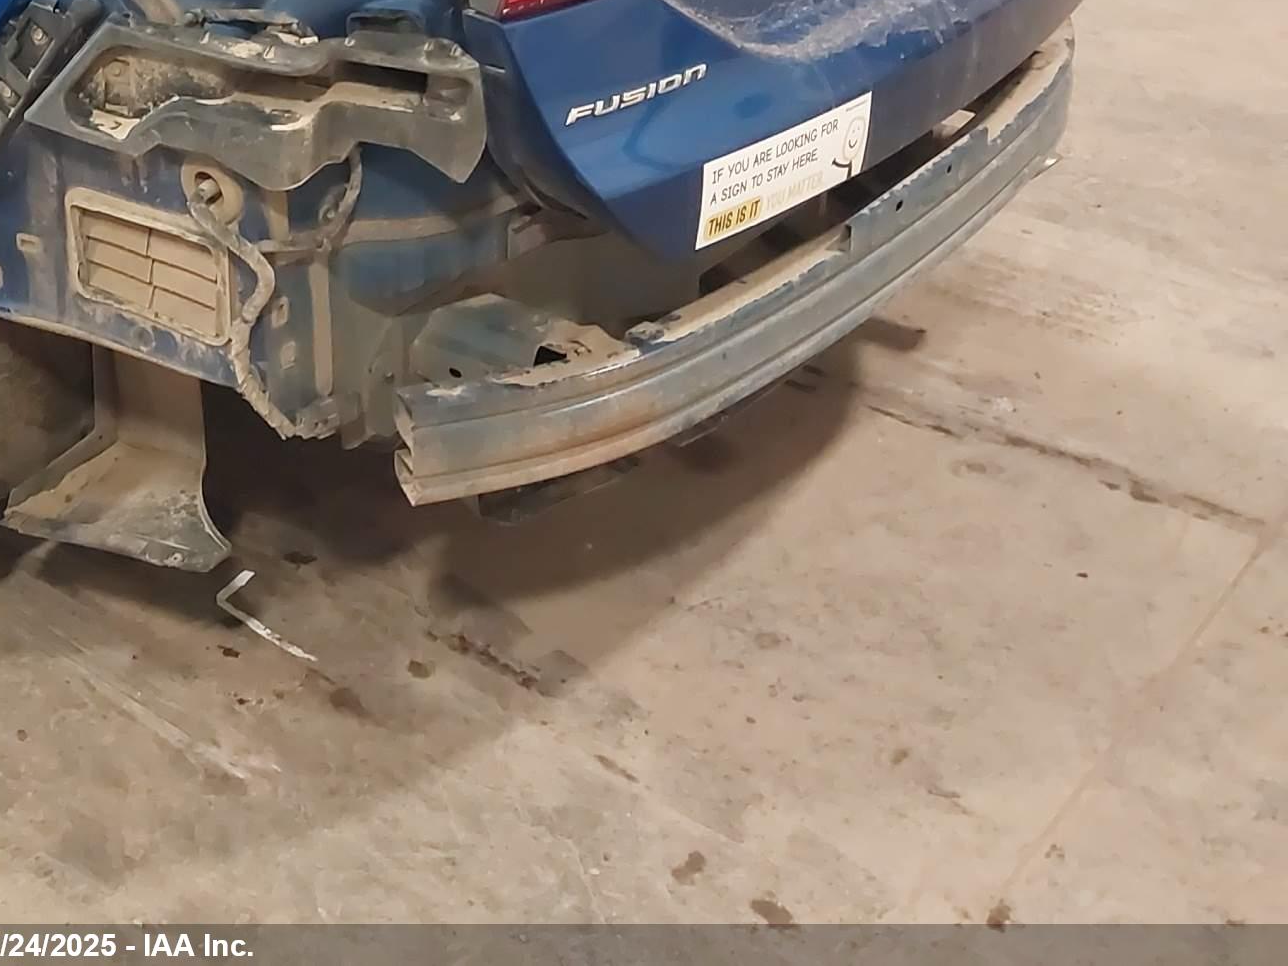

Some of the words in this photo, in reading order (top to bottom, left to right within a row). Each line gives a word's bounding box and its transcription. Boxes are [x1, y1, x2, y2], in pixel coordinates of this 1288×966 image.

[564, 62, 708, 127] FUSION
[712, 167, 724, 184] IF
[728, 156, 749, 176] YOU
[753, 147, 773, 167] ARE
[775, 128, 818, 158] LOOKING
[821, 118, 839, 137] FOR
[710, 191, 717, 205] A
[721, 180, 747, 202] SIGN
[752, 172, 763, 188] TO
[766, 161, 790, 182] STAY
[708, 208, 733, 237] THIS
[736, 205, 746, 223] IS
[749, 199, 761, 219] IT
